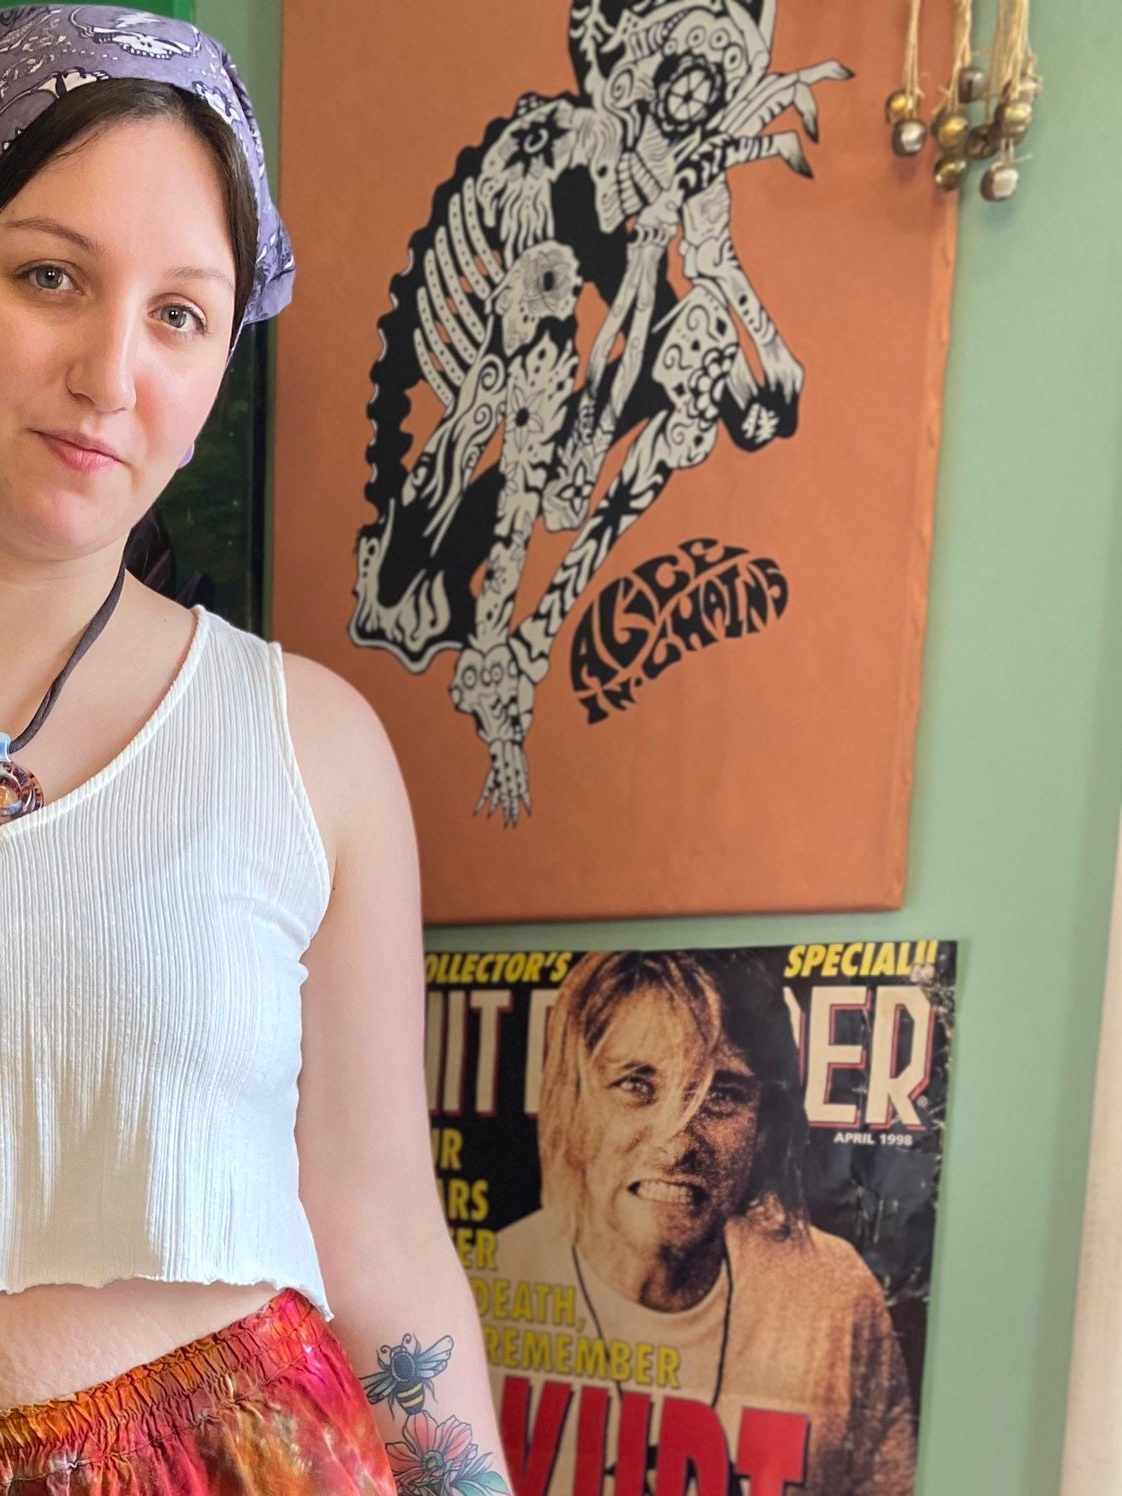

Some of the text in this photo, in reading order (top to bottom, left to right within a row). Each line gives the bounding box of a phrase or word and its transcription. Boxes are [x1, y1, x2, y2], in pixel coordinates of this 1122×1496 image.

[641, 557, 789, 681] CHAINS
[425, 952, 572, 984] OLLECTOR'S
[833, 1131, 914, 1147] APRIL 1998
[484, 1325, 682, 1389] REMEMBER
